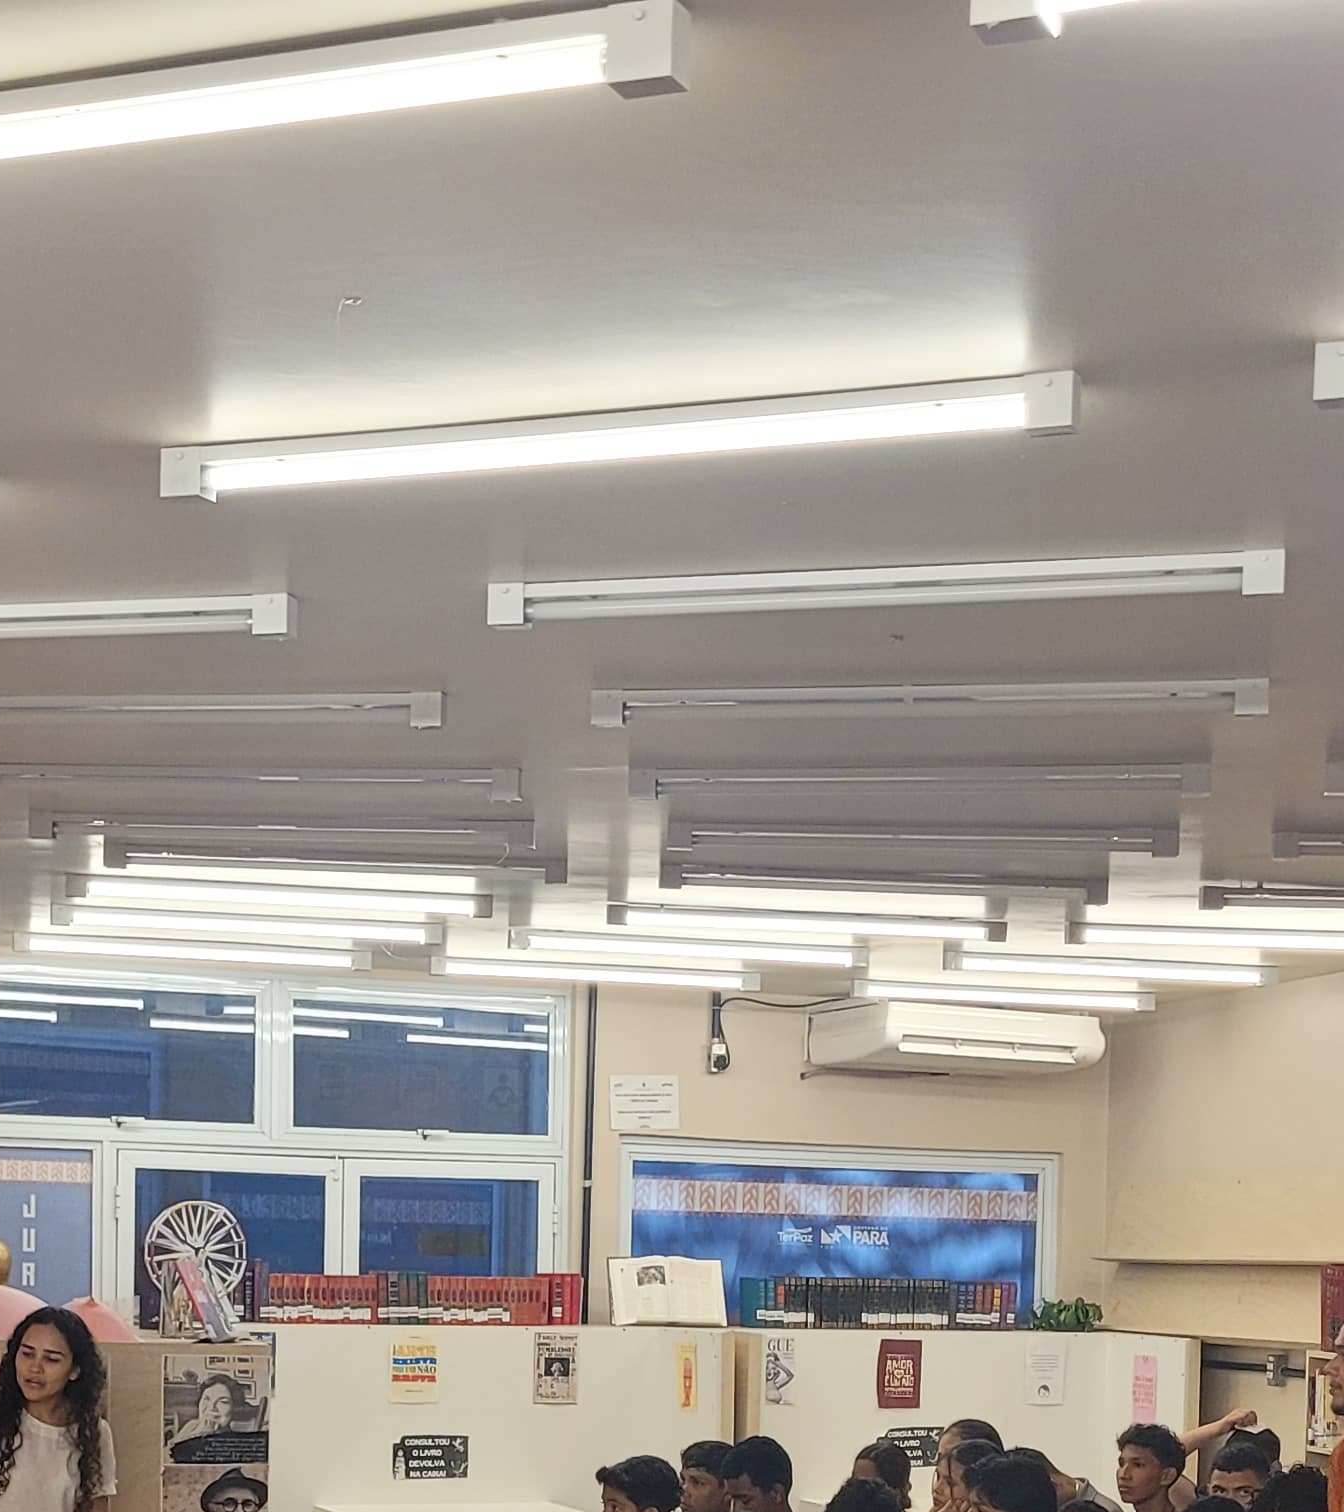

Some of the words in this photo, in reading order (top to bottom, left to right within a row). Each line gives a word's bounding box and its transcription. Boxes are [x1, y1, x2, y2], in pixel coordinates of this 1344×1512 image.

[777, 1231, 813, 1242] TerPaz
[886, 1359, 914, 1376] AMOR
[404, 1438, 450, 1446] CONSULTOU
[412, 1449, 418, 1457] O
[419, 1449, 442, 1457] LIVRO
[408, 1459, 446, 1468] DEVOLVA
